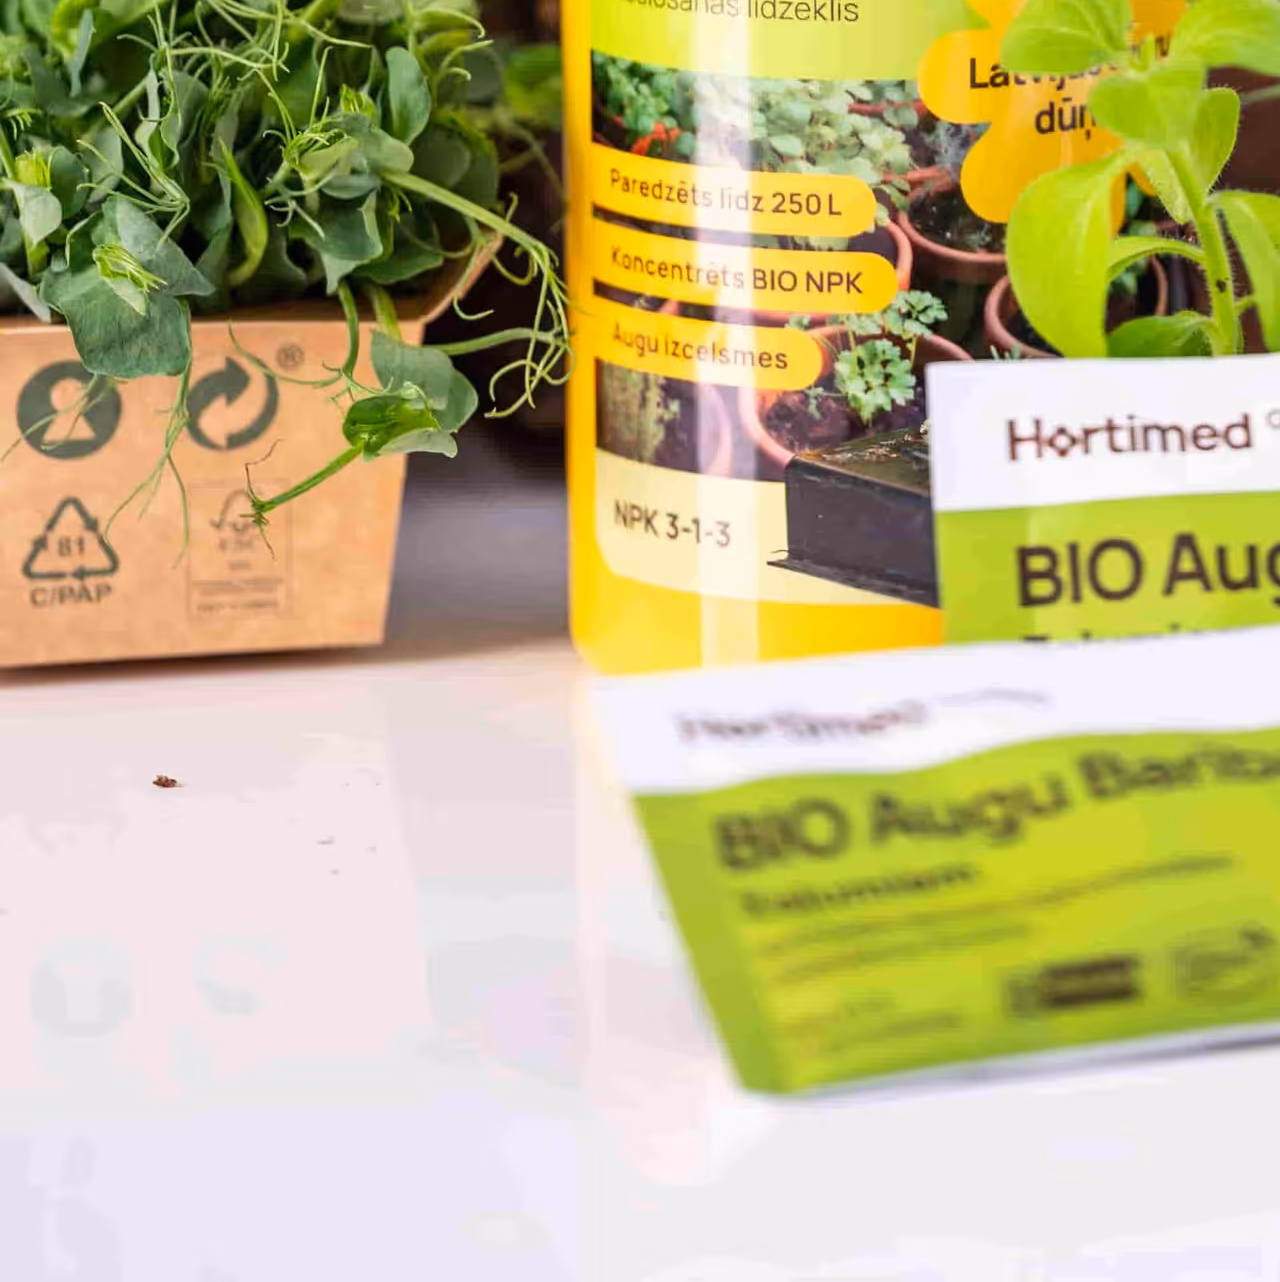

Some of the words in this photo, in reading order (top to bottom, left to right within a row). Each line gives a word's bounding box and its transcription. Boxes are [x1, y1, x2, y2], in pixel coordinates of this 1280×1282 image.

[610, 167, 712, 208] Paredzēts
[719, 185, 765, 213] līdz
[772, 191, 822, 216] 250
[828, 193, 843, 217] L
[611, 244, 745, 287] Koncentrēts
[752, 267, 798, 293] BIO
[805, 271, 864, 295] NPK
[613, 321, 660, 358] Augu
[664, 336, 789, 371] izcelsmes
[1006, 412, 1252, 462] Hortimed
[614, 499, 659, 538] NPK
[665, 512, 732, 549] 3-1-3
[1015, 537, 1143, 609] BIO
[713, 795, 851, 875] BIO
